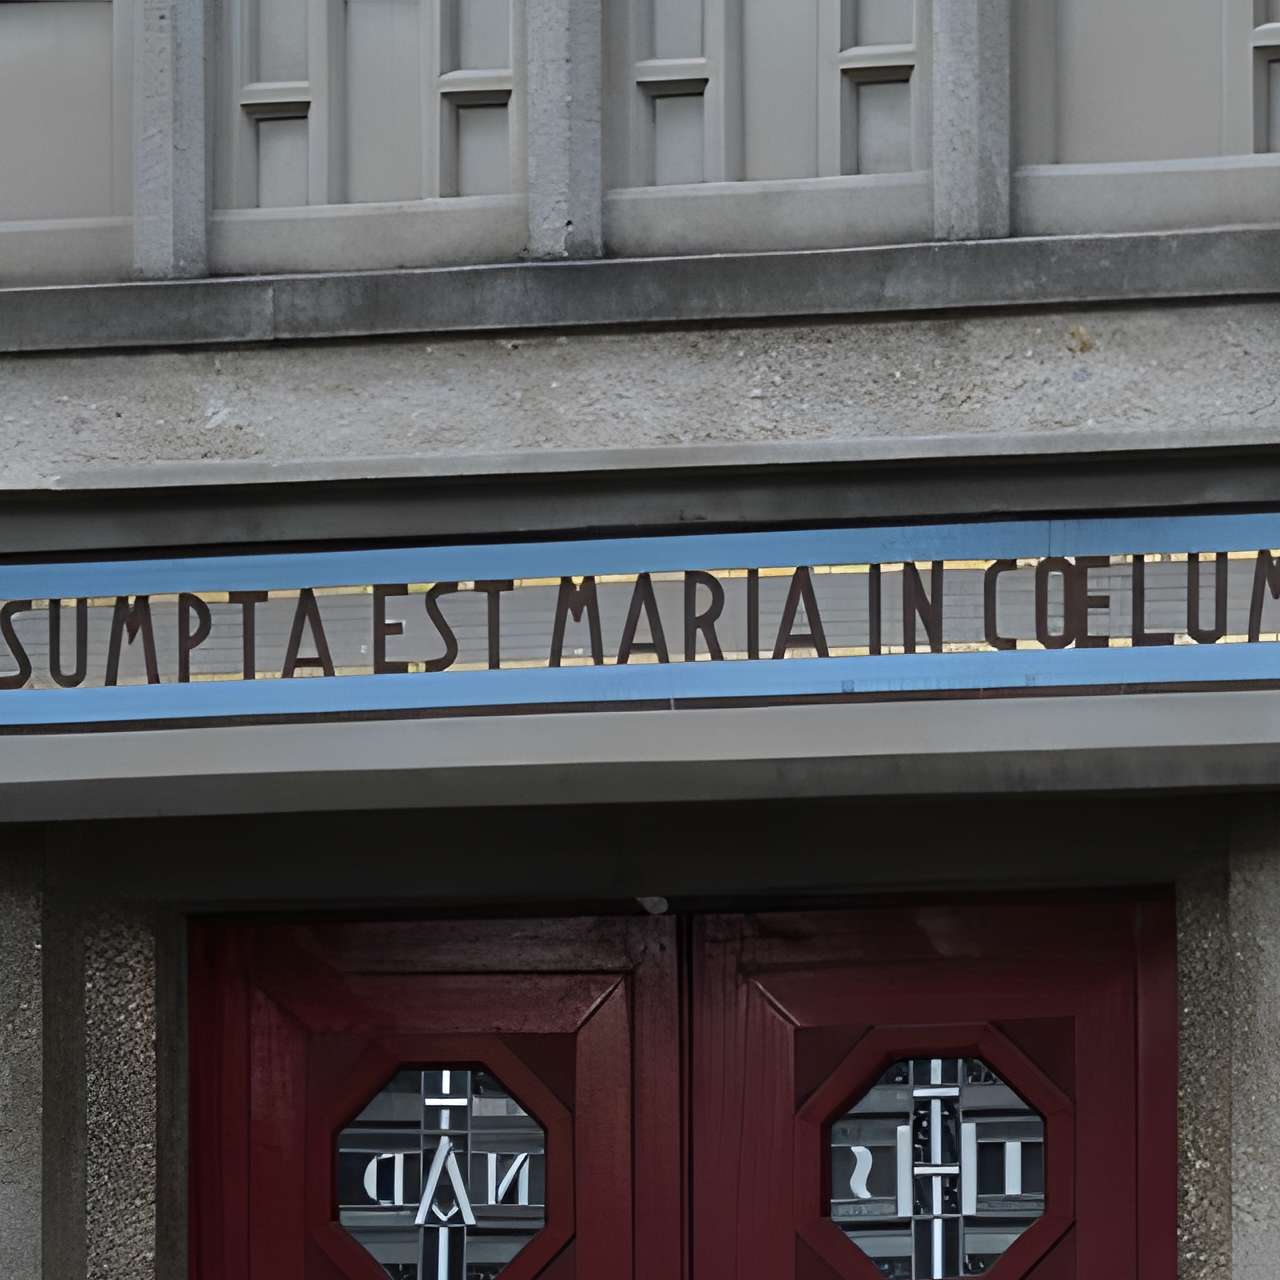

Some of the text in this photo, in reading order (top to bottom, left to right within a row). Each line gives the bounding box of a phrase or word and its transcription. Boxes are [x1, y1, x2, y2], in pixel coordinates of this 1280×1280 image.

[372, 579, 515, 674] EST
[549, 565, 830, 668] MARIA
[868, 559, 944, 656] IN
